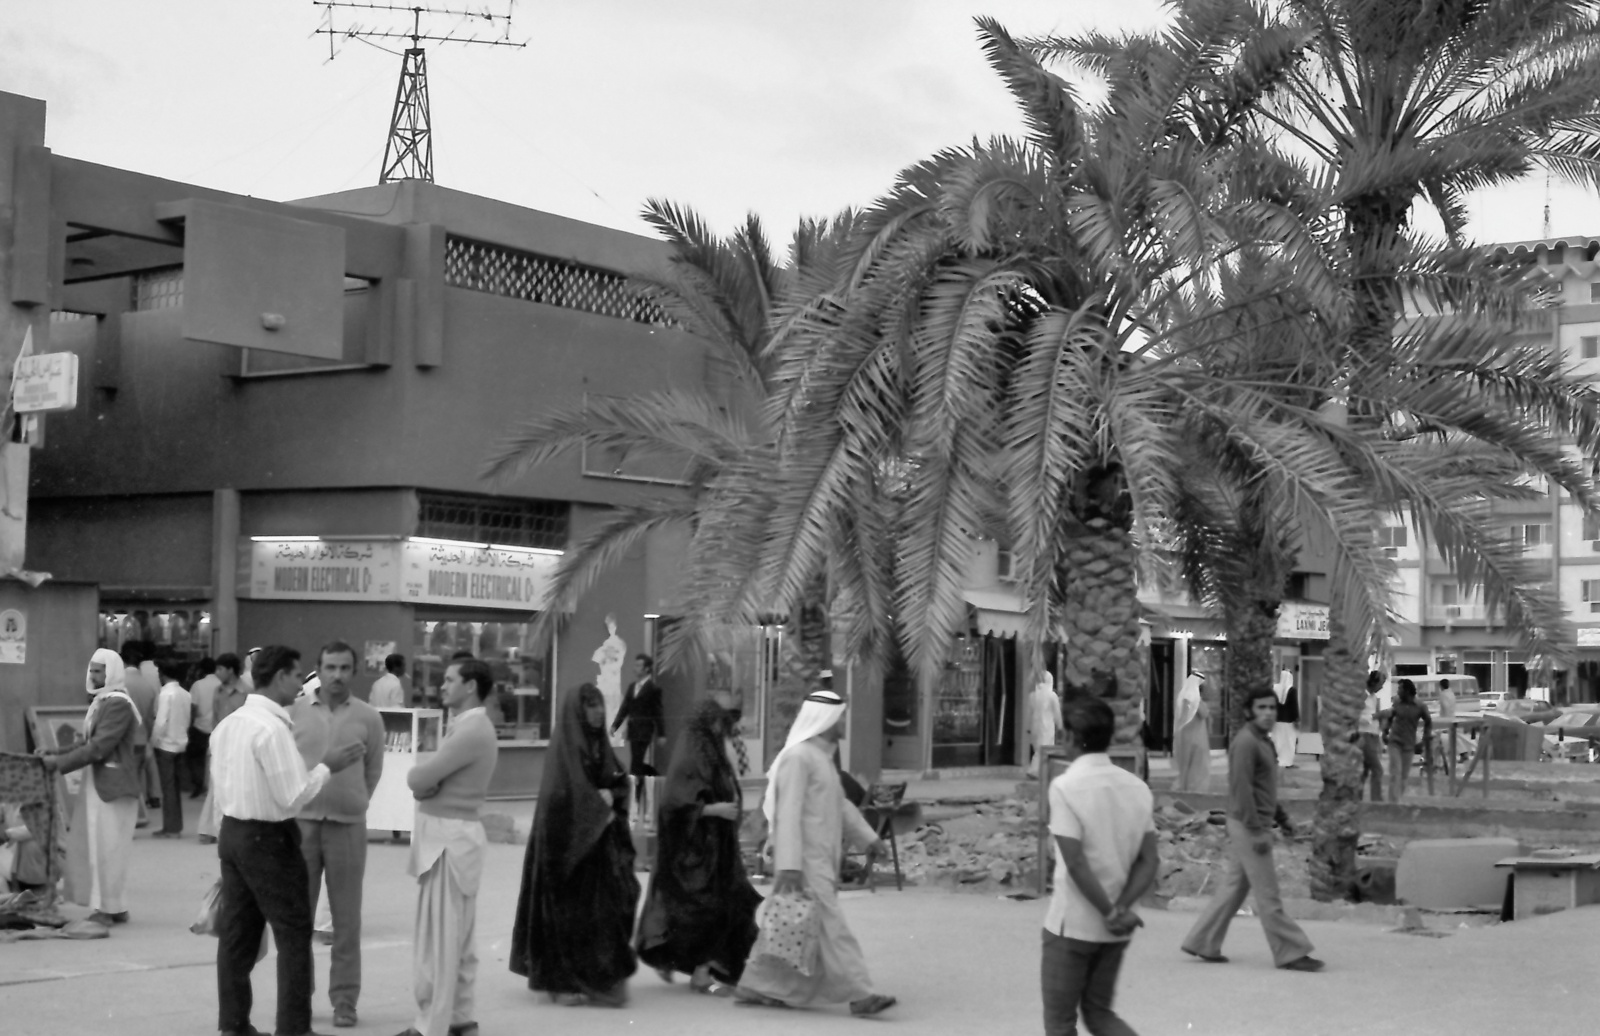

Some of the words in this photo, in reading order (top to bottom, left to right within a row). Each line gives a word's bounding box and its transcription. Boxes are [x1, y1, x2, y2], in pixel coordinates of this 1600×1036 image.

[338, 543, 373, 561] شركة
[429, 545, 466, 566] الحديثة
[499, 552, 535, 571] شركة
[274, 566, 309, 592] MODERN
[311, 566, 360, 592] ELECTRICAL
[428, 569, 468, 597] MODERN
[470, 572, 522, 601] ELECTRICAL
